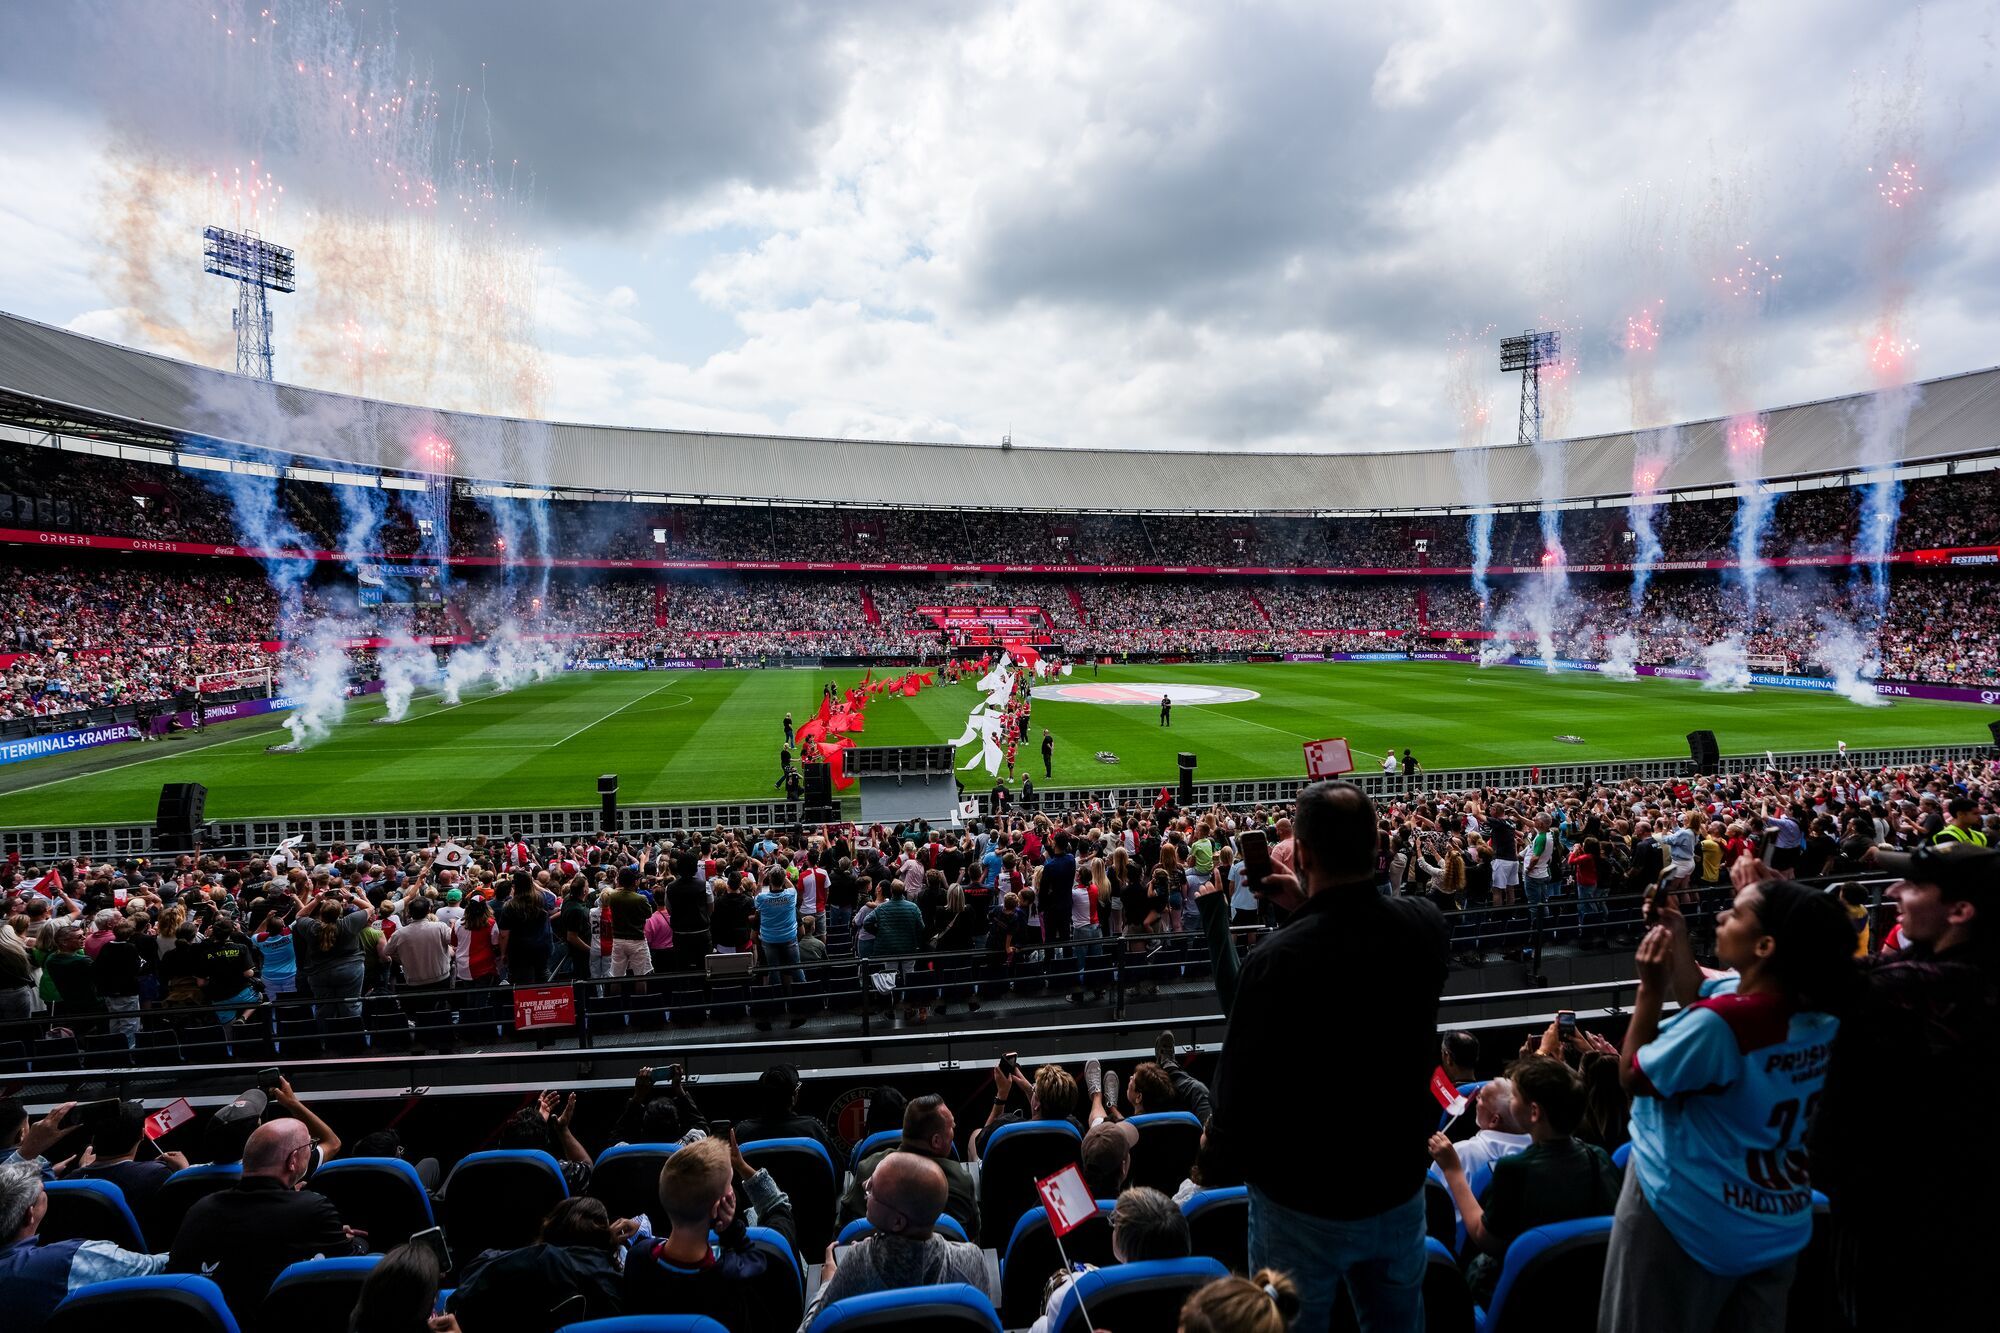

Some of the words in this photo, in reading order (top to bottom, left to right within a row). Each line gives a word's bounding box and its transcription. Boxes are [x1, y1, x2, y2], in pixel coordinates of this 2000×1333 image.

[39, 533, 84, 545] ORMER
[132, 540, 171, 551] ORMER
[1292, 653, 1325, 661] QTERMINALS
[1654, 667, 1696, 676] QTERMINALS
